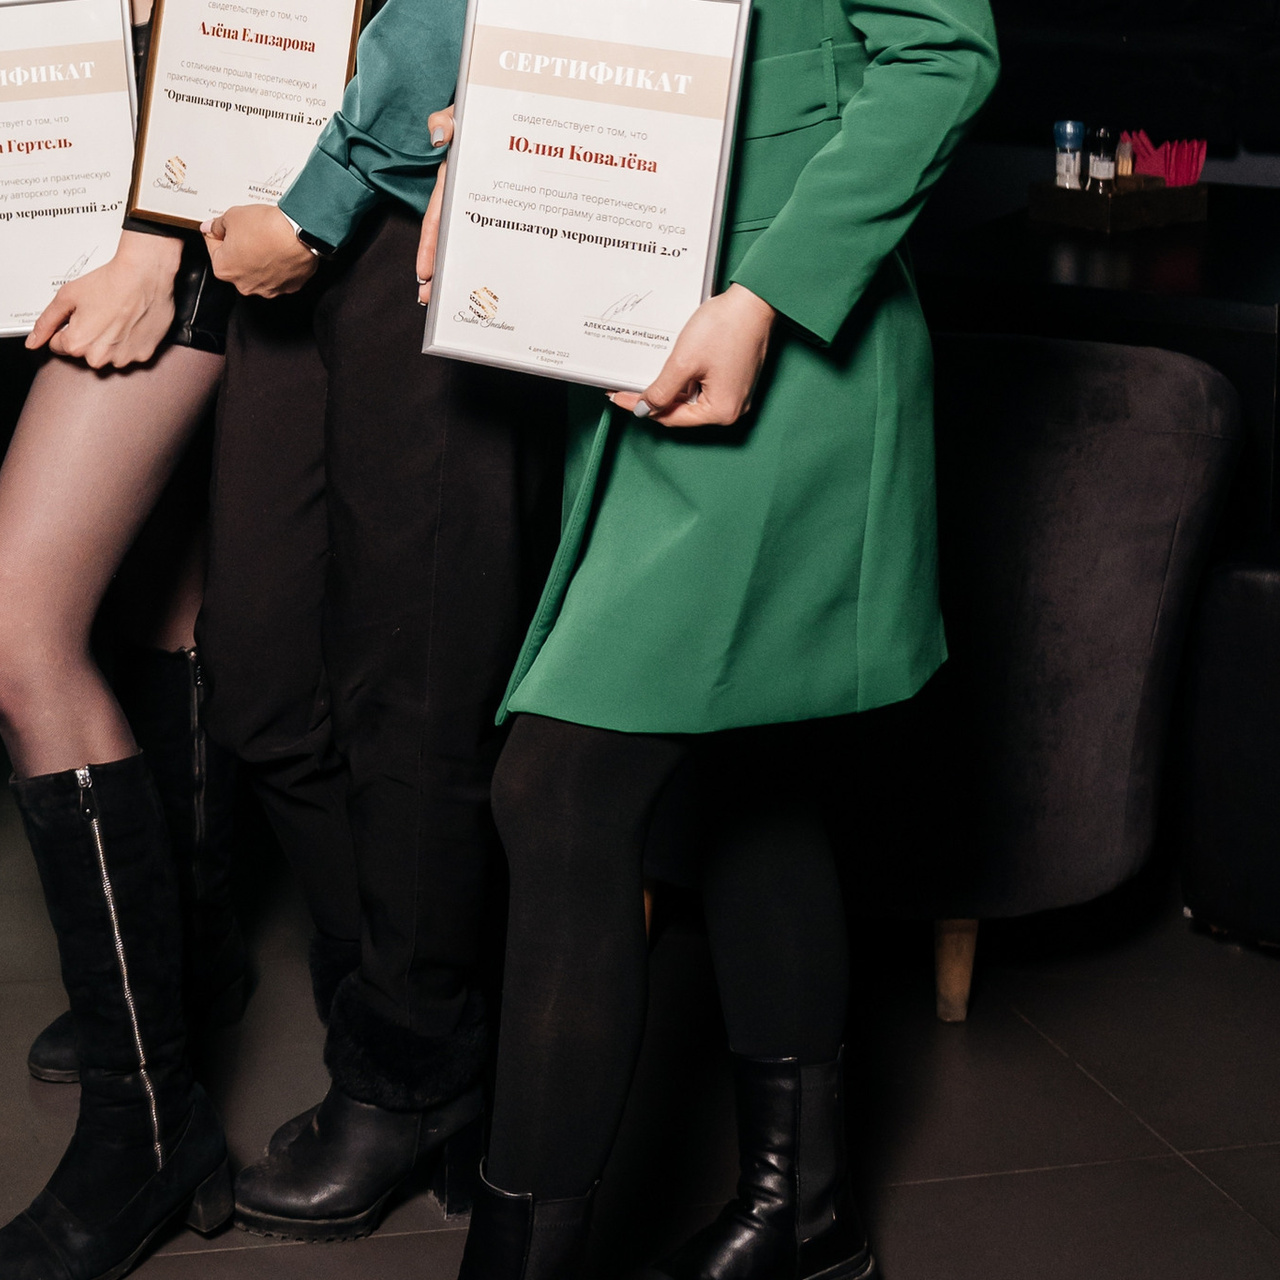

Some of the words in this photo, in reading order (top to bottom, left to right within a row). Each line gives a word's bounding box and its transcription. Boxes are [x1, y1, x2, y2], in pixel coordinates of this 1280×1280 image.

[208, 1, 269, 18] свидетельствует
[270, 10, 276, 18] о
[277, 11, 292, 21] том,
[294, 14, 308, 23] что
[198, 22, 238, 40] Алёна
[242, 28, 315, 52] Елизарова
[180, 60, 185, 68] с
[186, 61, 222, 73] отличием
[222, 67, 252, 79] прошла
[254, 72, 310, 89] теоретическую
[499, 50, 692, 94] СЕРТИФИКАТ
[166, 72, 217, 88] практическую
[218, 81, 259, 94] программу
[259, 88, 302, 102] авторского
[305, 97, 326, 107] курса
[164, 88, 232, 112] "Организатор
[234, 103, 304, 123] мероприятий
[306, 117, 328, 127] 2.0"
[512, 114, 595, 134] свидетельствует
[597, 126, 604, 134] о
[607, 127, 627, 138] том,
[630, 132, 648, 141] что
[7, 138, 72, 154] Гертель
[509, 136, 564, 158] Юлия
[569, 145, 657, 173] Ковалёва
[50, 171, 111, 184] практическую
[248, 185, 283, 198] АЛЕКСАНДРА
[10, 189, 59, 200] авторского
[63, 187, 86, 197] курса
[492, 180, 537, 194] успешно
[539, 187, 578, 200] прошла
[581, 194, 657, 214] теоретическую
[16, 202, 97, 220] мероприятий
[101, 201, 123, 212] 2.0"
[468, 192, 537, 211] практическую
[539, 204, 594, 222] программу
[595, 213, 653, 230] авторского
[658, 224, 686, 235] курса
[465, 211, 558, 239] "Организатор
[562, 230, 656, 254] мероприятий
[660, 246, 688, 257] 2.0"
[584, 321, 630, 334] АЛЕКСАНДРА
[632, 330, 670, 342] ИНЁШИНА
